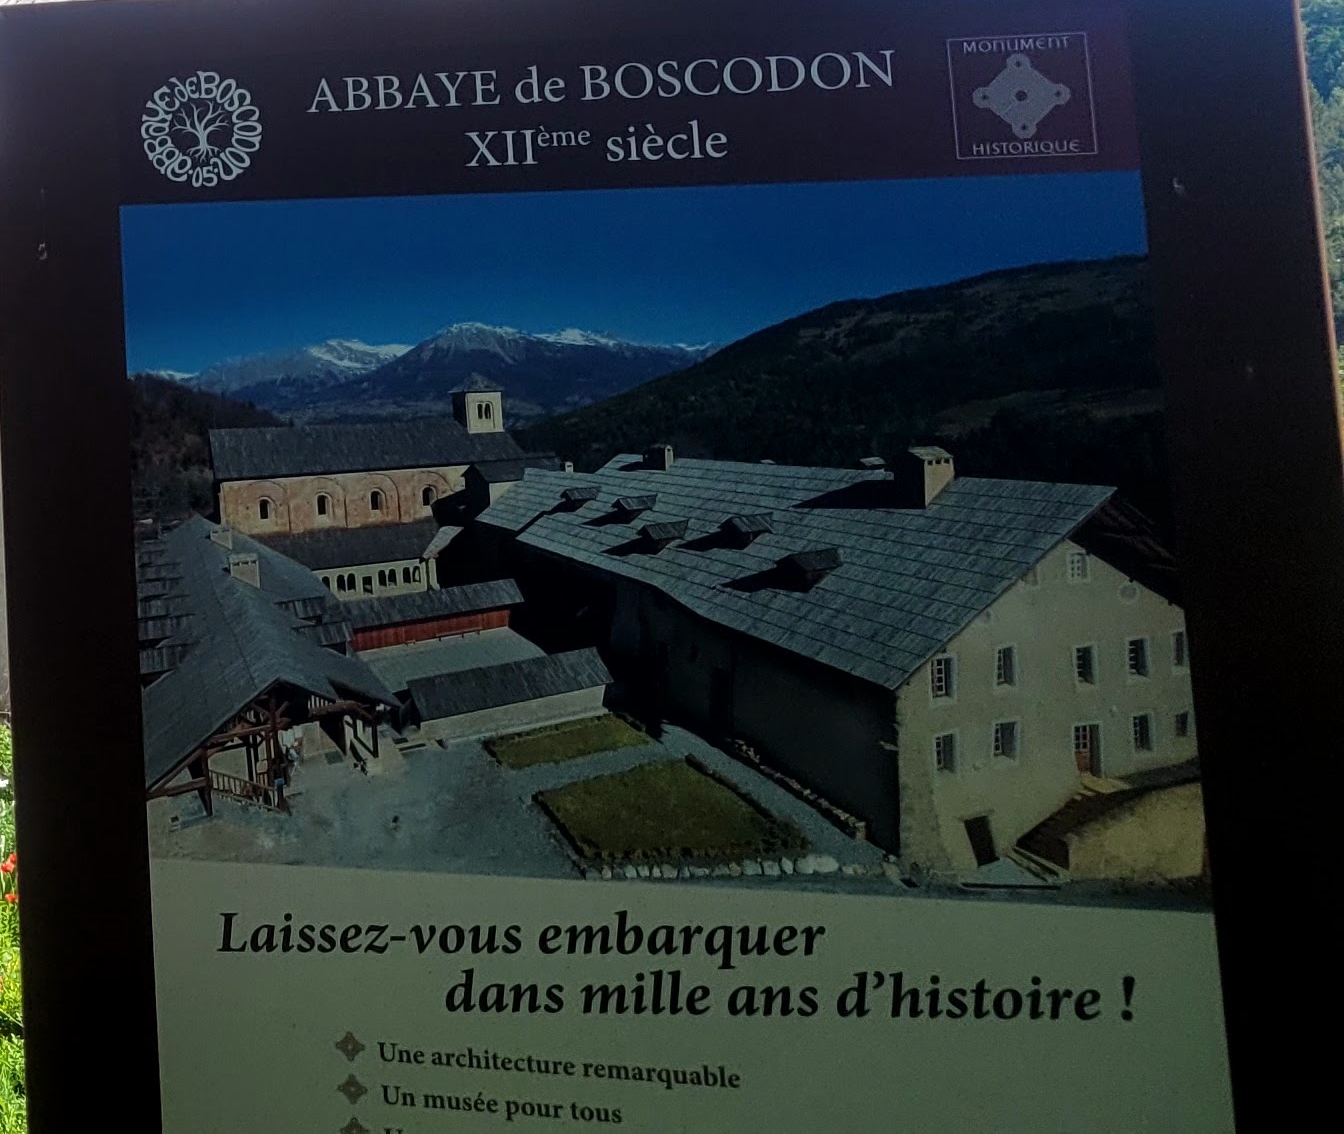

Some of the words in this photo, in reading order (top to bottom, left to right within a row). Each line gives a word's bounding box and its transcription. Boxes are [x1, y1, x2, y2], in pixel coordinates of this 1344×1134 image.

[962, 36, 1071, 54] MONUMENT
[306, 70, 501, 113] ABBAYE
[514, 65, 566, 105] de
[580, 49, 896, 102] BOSCODON
[606, 118, 728, 163] siècle
[972, 139, 1080, 156] HISTORIQUE
[217, 911, 523, 955] Laissez-vous
[538, 909, 826, 970] embarquer
[445, 968, 564, 1015] dans
[580, 968, 711, 1017] mille
[727, 981, 819, 1018] ans
[377, 1042, 425, 1065] Une
[431, 1047, 575, 1076] architecture
[582, 1062, 741, 1090] remarquable
[381, 1084, 416, 1107] Un
[423, 1091, 499, 1113] musée
[505, 1099, 563, 1121] pour
[570, 1101, 623, 1124] tous
